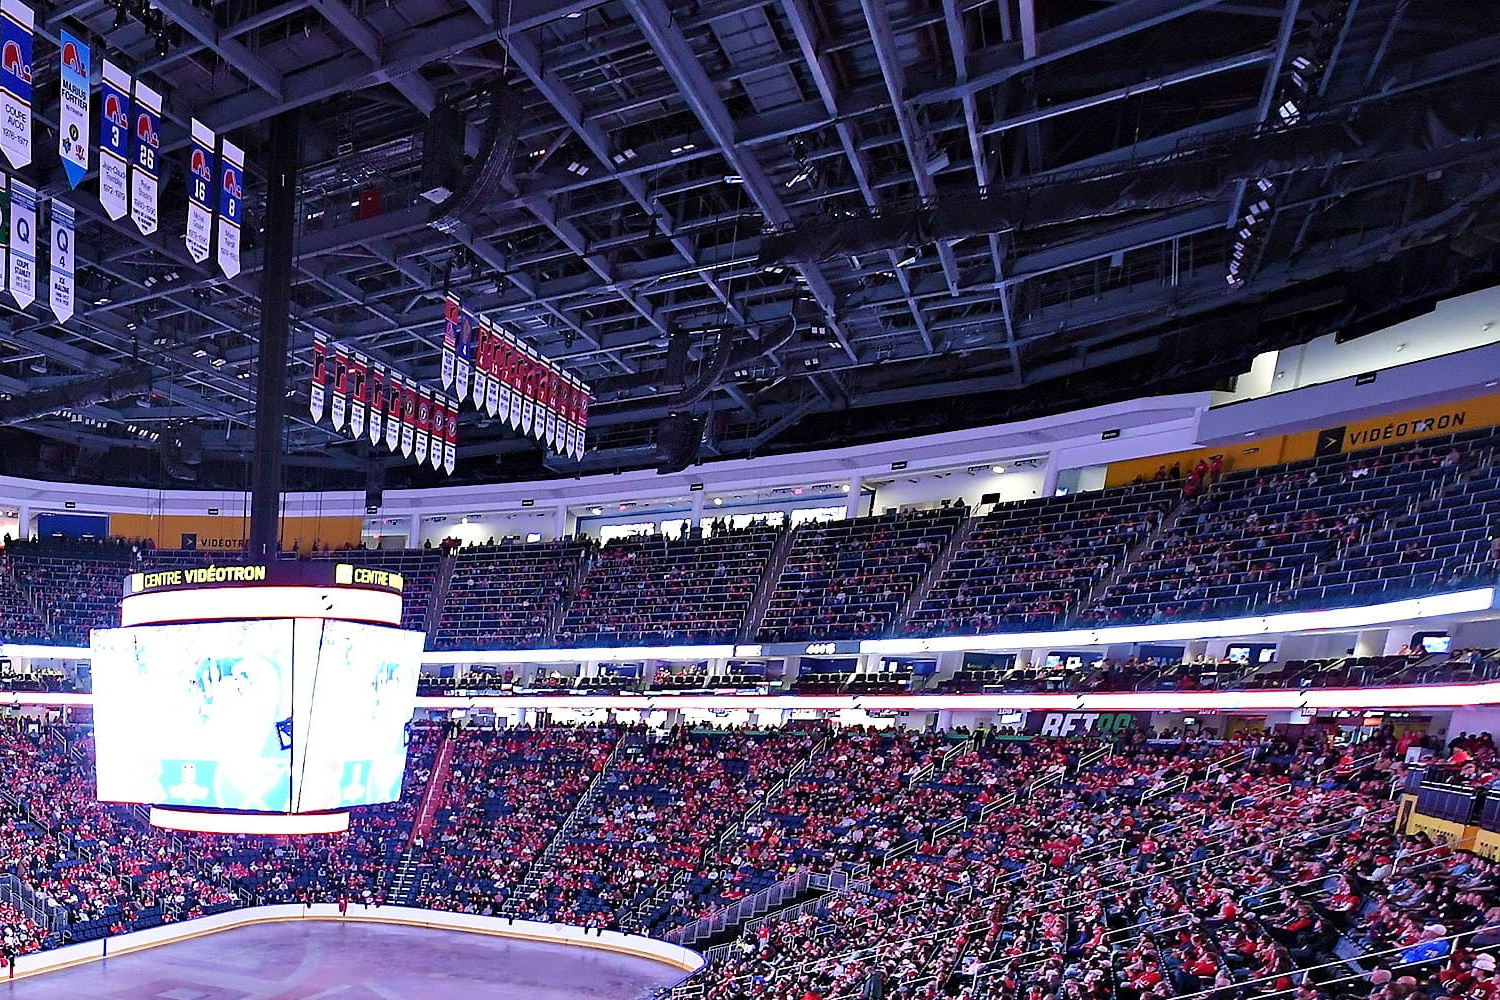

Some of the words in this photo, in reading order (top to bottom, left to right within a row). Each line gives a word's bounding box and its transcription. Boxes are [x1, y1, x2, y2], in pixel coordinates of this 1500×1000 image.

[62, 79, 86, 100] MARIUS
[62, 90, 88, 112] FORTIER
[6, 104, 27, 123] COUPE
[7, 116, 24, 131] AVCO
[111, 128, 119, 147] 3
[140, 144, 154, 170] 26
[194, 179, 206, 201] 16
[228, 199, 235, 216] 8
[17, 217, 29, 244] Q
[57, 228, 68, 254] Q
[60, 256, 66, 267] 4
[1350, 412, 1466, 446] VIDÉOTRON
[201, 538, 250, 548] VIDÉOTR
[144, 570, 182, 588] CENTRE
[184, 564, 266, 584] VIDÉOTRON
[354, 568, 388, 585] CENTRE
